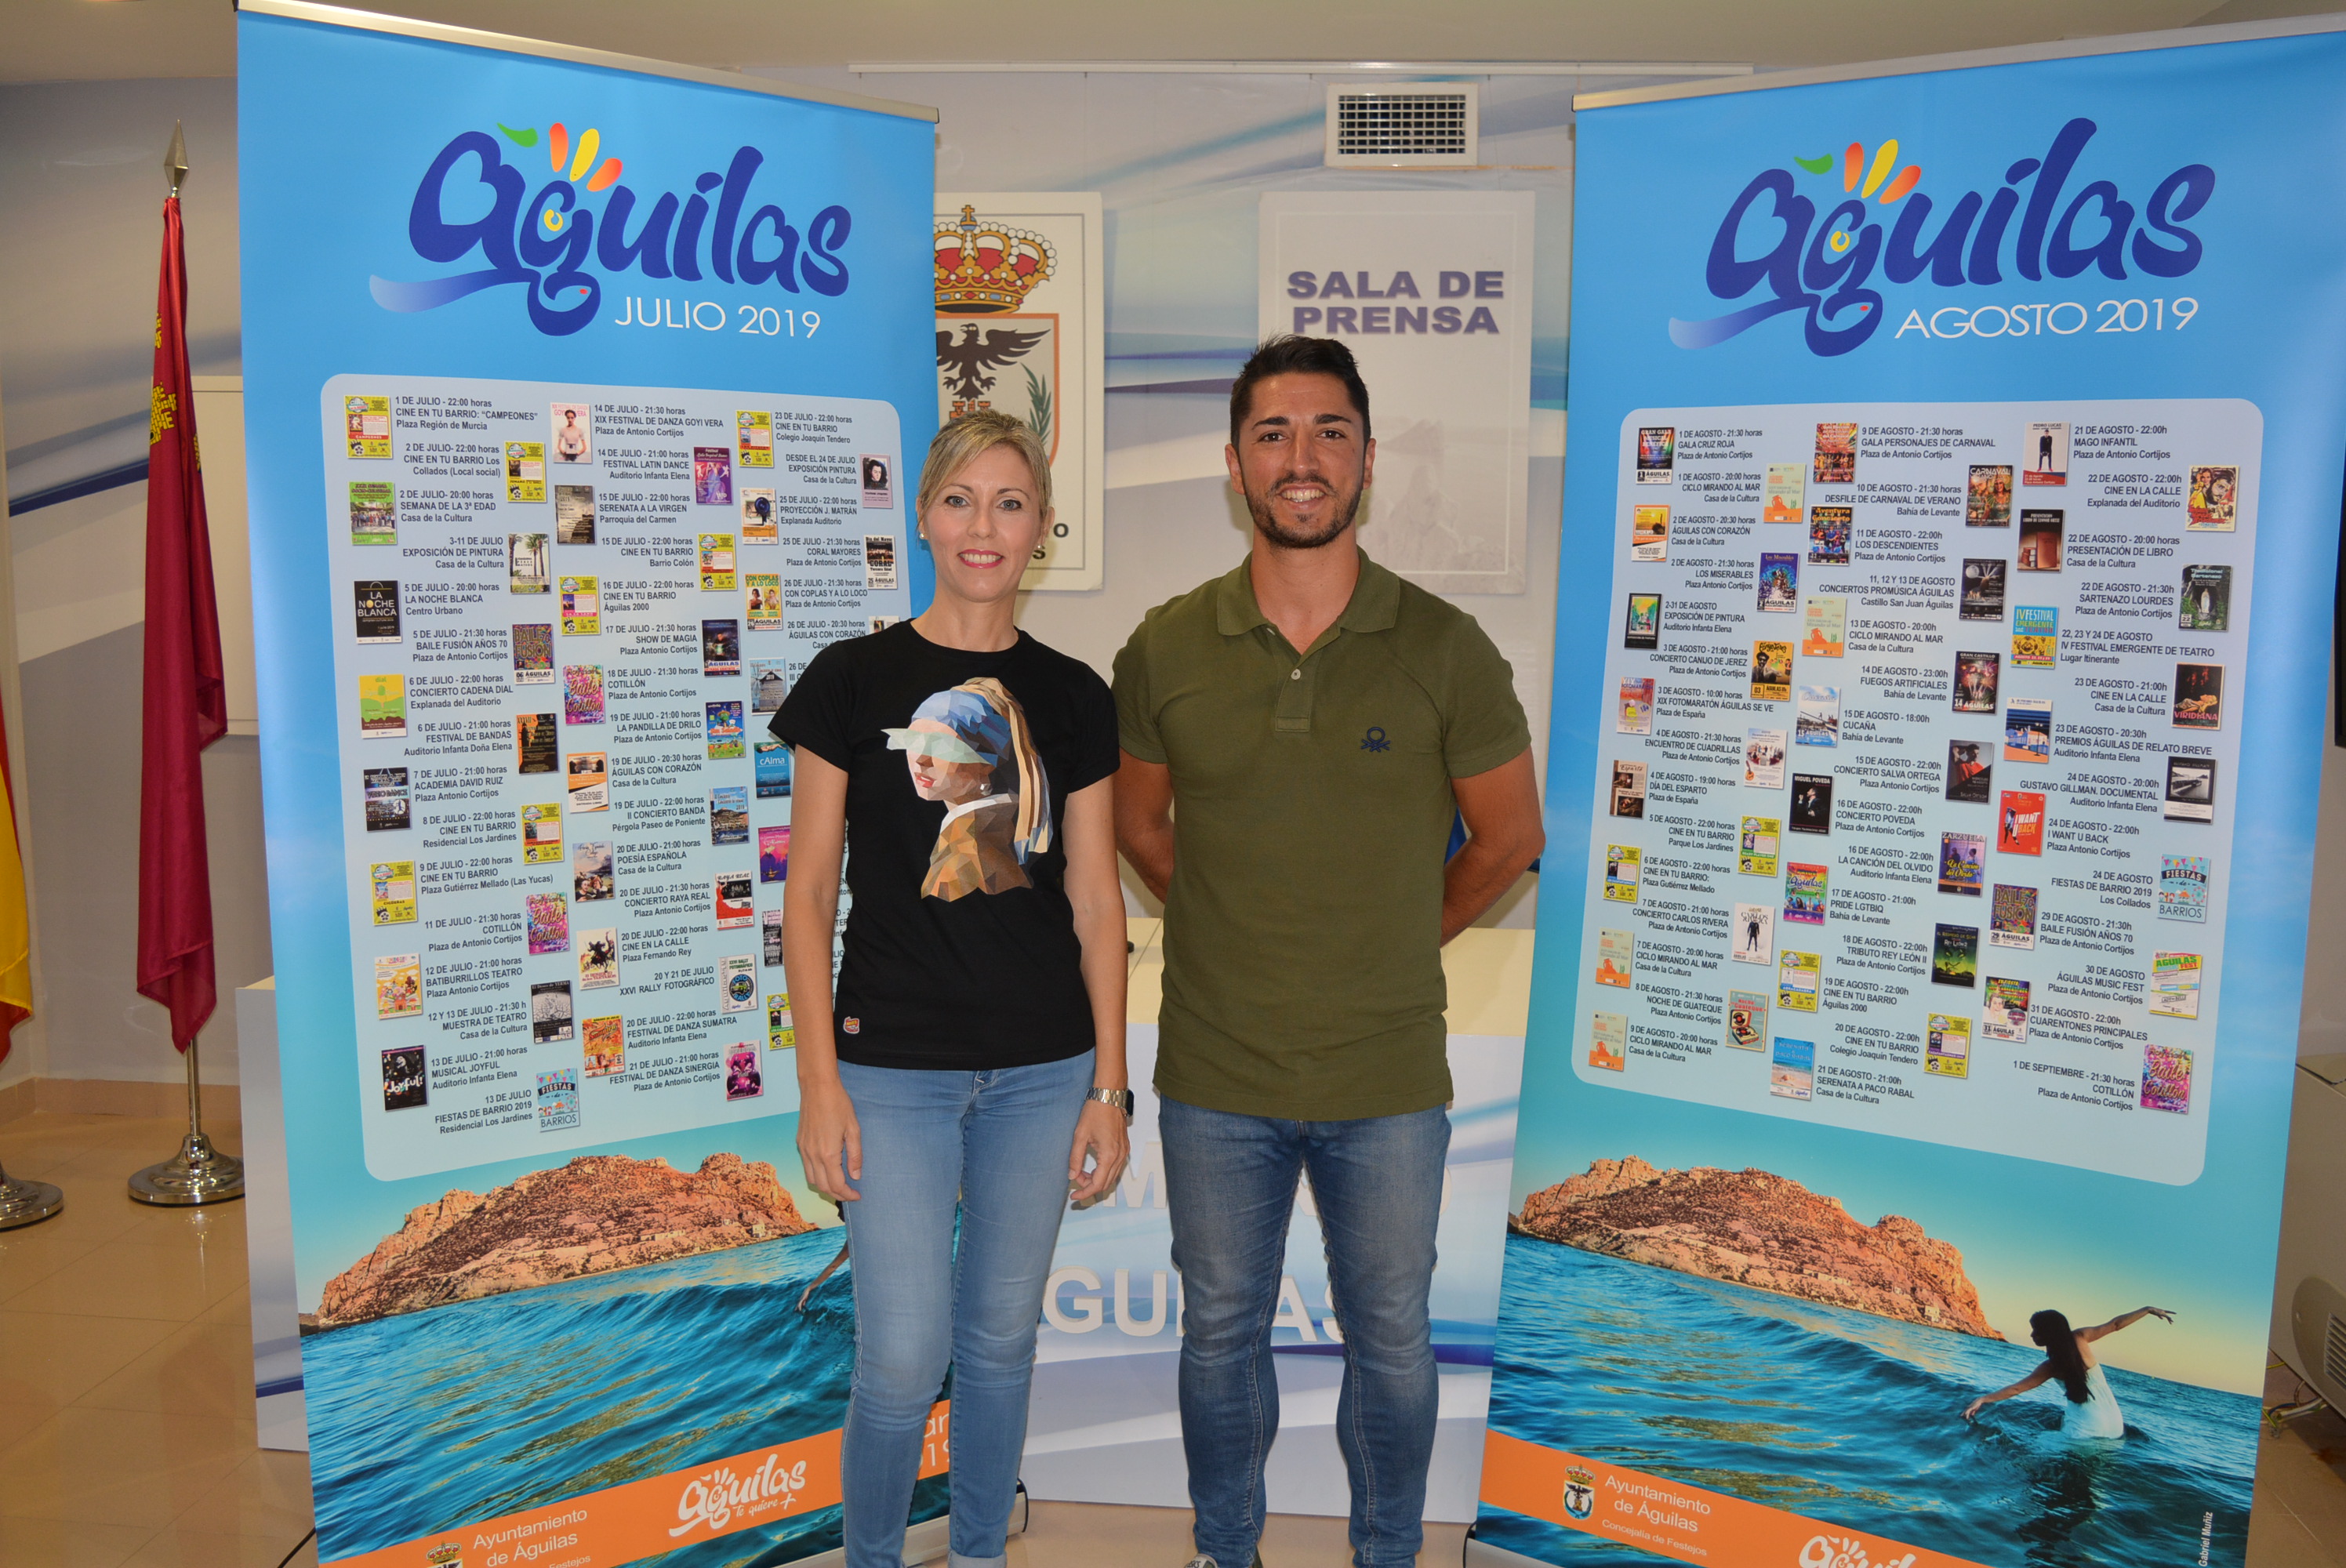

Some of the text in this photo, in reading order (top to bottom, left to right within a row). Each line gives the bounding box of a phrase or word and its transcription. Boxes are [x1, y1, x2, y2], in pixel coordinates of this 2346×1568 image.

[1287, 270, 1504, 299] SALA DE
[615, 296, 821, 339] JULIO 2019
[1294, 306, 1500, 335] PRENSA
[1894, 297, 2199, 339] AGOSTO 2019
[395, 408, 416, 416] CINE
[418, 408, 430, 417] EN
[431, 408, 443, 417] TU
[1678, 440, 1735, 449] GALA CRUZ ROJA
[2074, 437, 2137, 447] MAGO INFANTIL
[780, 505, 823, 514] PROYECCIÓN
[831, 506, 857, 515] MATRÁN
[402, 546, 504, 557] EXPOSICIÓN DE PINTURA
[807, 547, 861, 556] CORAL MAYORES
[2067, 544, 2174, 557] PRESENTACIÓN DE LIBRO
[370, 591, 383, 600] LA
[1819, 583, 1955, 597] CONCIERTOS PROMÚSICA ÁGUILAS
[358, 599, 395, 608] NOCHE
[405, 594, 484, 604] LA NOCHE BLANCA
[1861, 597, 1954, 611] Castillo San Juan Águilas
[2079, 593, 2174, 606] SARTENAZO LOURDES
[358, 608, 397, 617] BLANCA
[2061, 641, 2215, 657] IV FESTIVAL EMERGENTE DE TEATRO
[1656, 696, 1774, 713] XIX FOTOMARATÓN ÁGUILAS SE VE
[2174, 710, 2218, 720] VIRIDIANA
[616, 720, 702, 732] LA PANDILLA DE DRILO
[1843, 720, 1876, 731] CUCAÑA
[1644, 739, 1741, 754] ENCUENTRO DE CUADRILLAS
[2054, 735, 2212, 756] PREMIOS ÁGUILAS DE RELATO BREVE
[414, 776, 503, 790] ACADEMIA DAVID RUIZ
[612, 817, 706, 833] Pérgola Paseo de Poniente
[2018, 811, 2041, 824] WANT
[2018, 823, 2037, 834] BACK
[617, 850, 687, 864] POESÍA ESPAÑOLA
[2166, 869, 2202, 881] FIESTAS
[624, 891, 710, 908] CONCIERTO RAYA REAL
[2159, 904, 2203, 919] BARRIOS
[426, 967, 523, 987] BATIBURRILLOS TEATRO
[2056, 971, 2144, 993] ÁGUILAS MUSIC FEST
[619, 976, 715, 996] XXVI RALLY FOTOGRÁFICO
[1646, 995, 1723, 1014] NOCHE DE GUATEQUE
[627, 1016, 737, 1039] FESTIVAL DE DANZA SUMATRA
[2029, 1015, 2148, 1041] CUARENTONES PRINCIPALES
[431, 1060, 500, 1079] MUSICAL JOYFUL
[542, 1083, 572, 1094] FIESTAS
[2092, 1083, 2134, 1099] COTILLÓN
[434, 1100, 532, 1123] FIESTAS DE BARRIO 2019
[540, 1113, 576, 1128] BARRIOS
[1605, 1475, 1711, 1515] Ayuntamiento
[748, 1498, 779, 1517] quiere
[1614, 1498, 1698, 1533] de Águilas
[473, 1509, 587, 1549] Ayuntamiento
[1602, 1519, 1708, 1556] Concejalía de Festejos
[2198, 1511, 2213, 1567] Gabriel Muñiz
[487, 1533, 578, 1567] de Águilas
